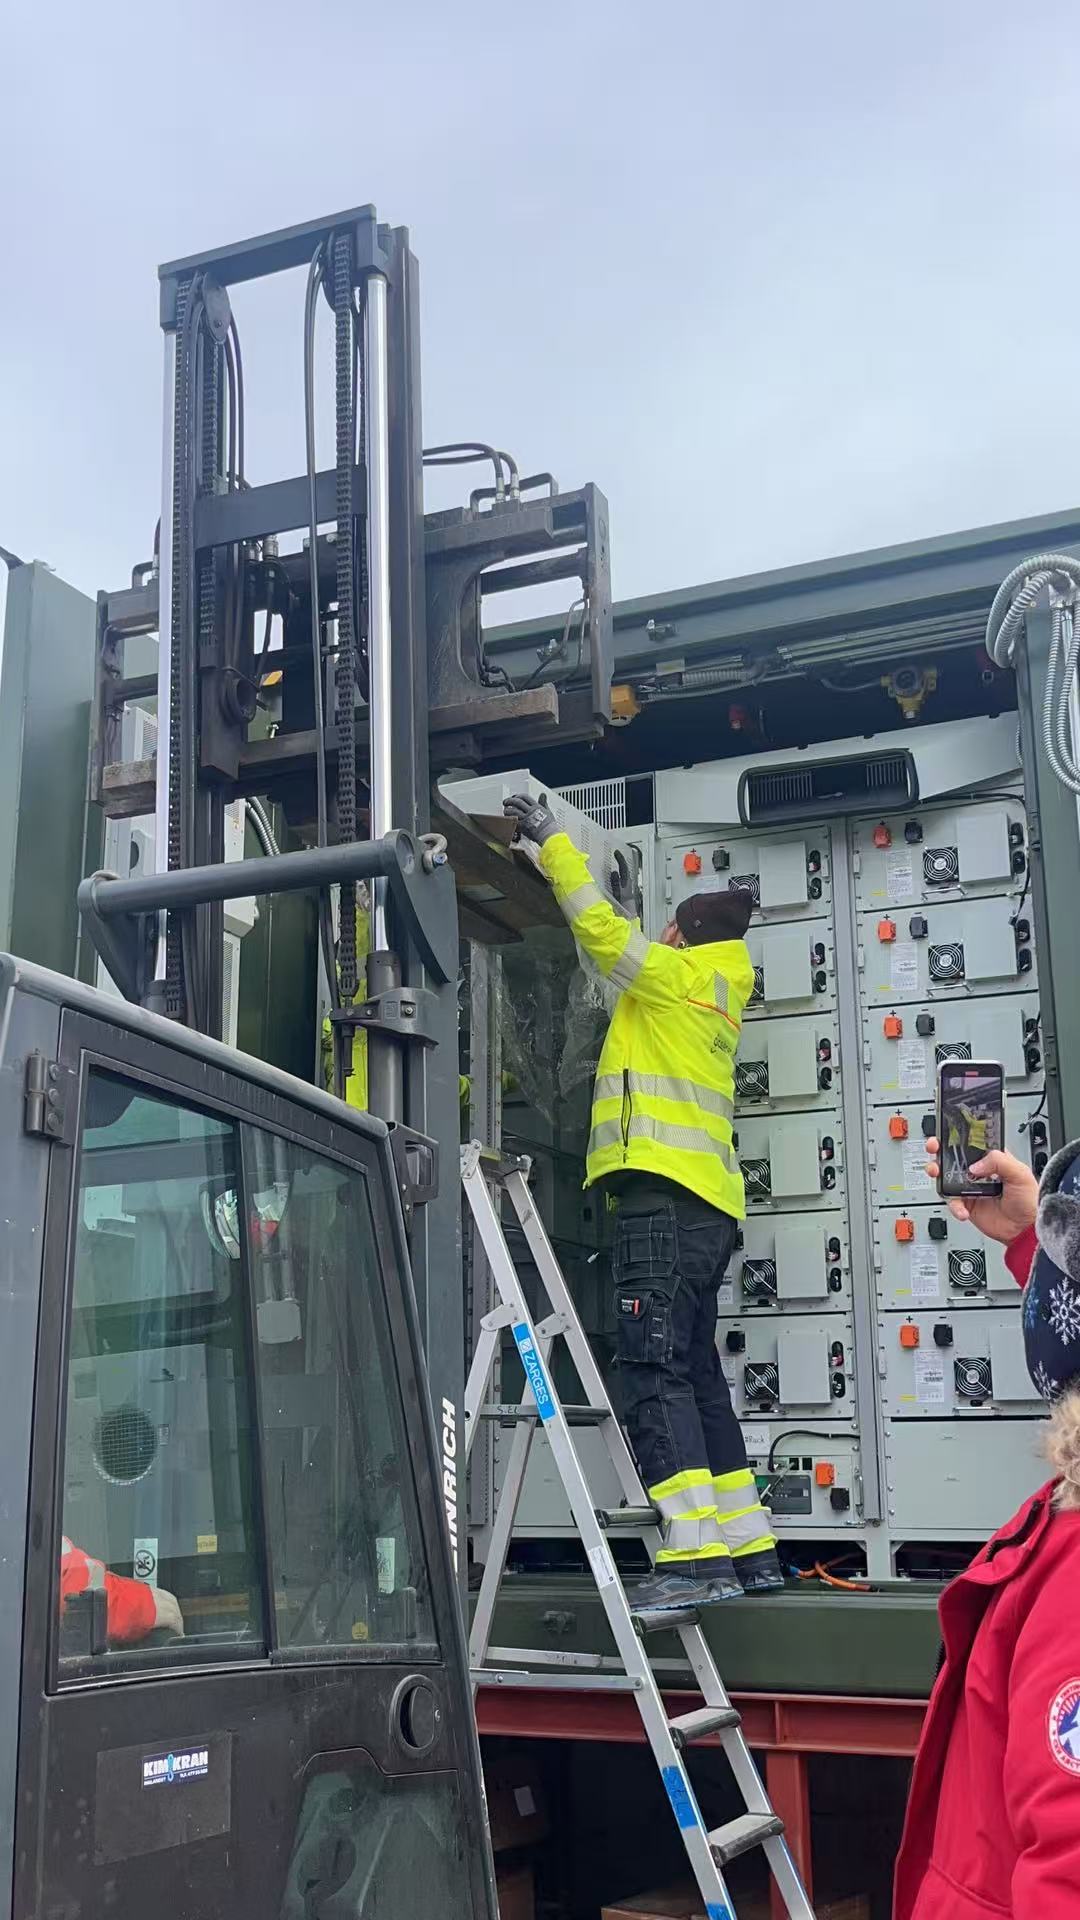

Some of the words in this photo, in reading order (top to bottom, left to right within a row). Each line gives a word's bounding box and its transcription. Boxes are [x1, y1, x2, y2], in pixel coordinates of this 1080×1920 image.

[524, 1352, 549, 1405] ZARGES
[442, 1397, 458, 1584] INRICH
[144, 1759, 169, 1777] KIM
[173, 1751, 208, 1771] KRAN
